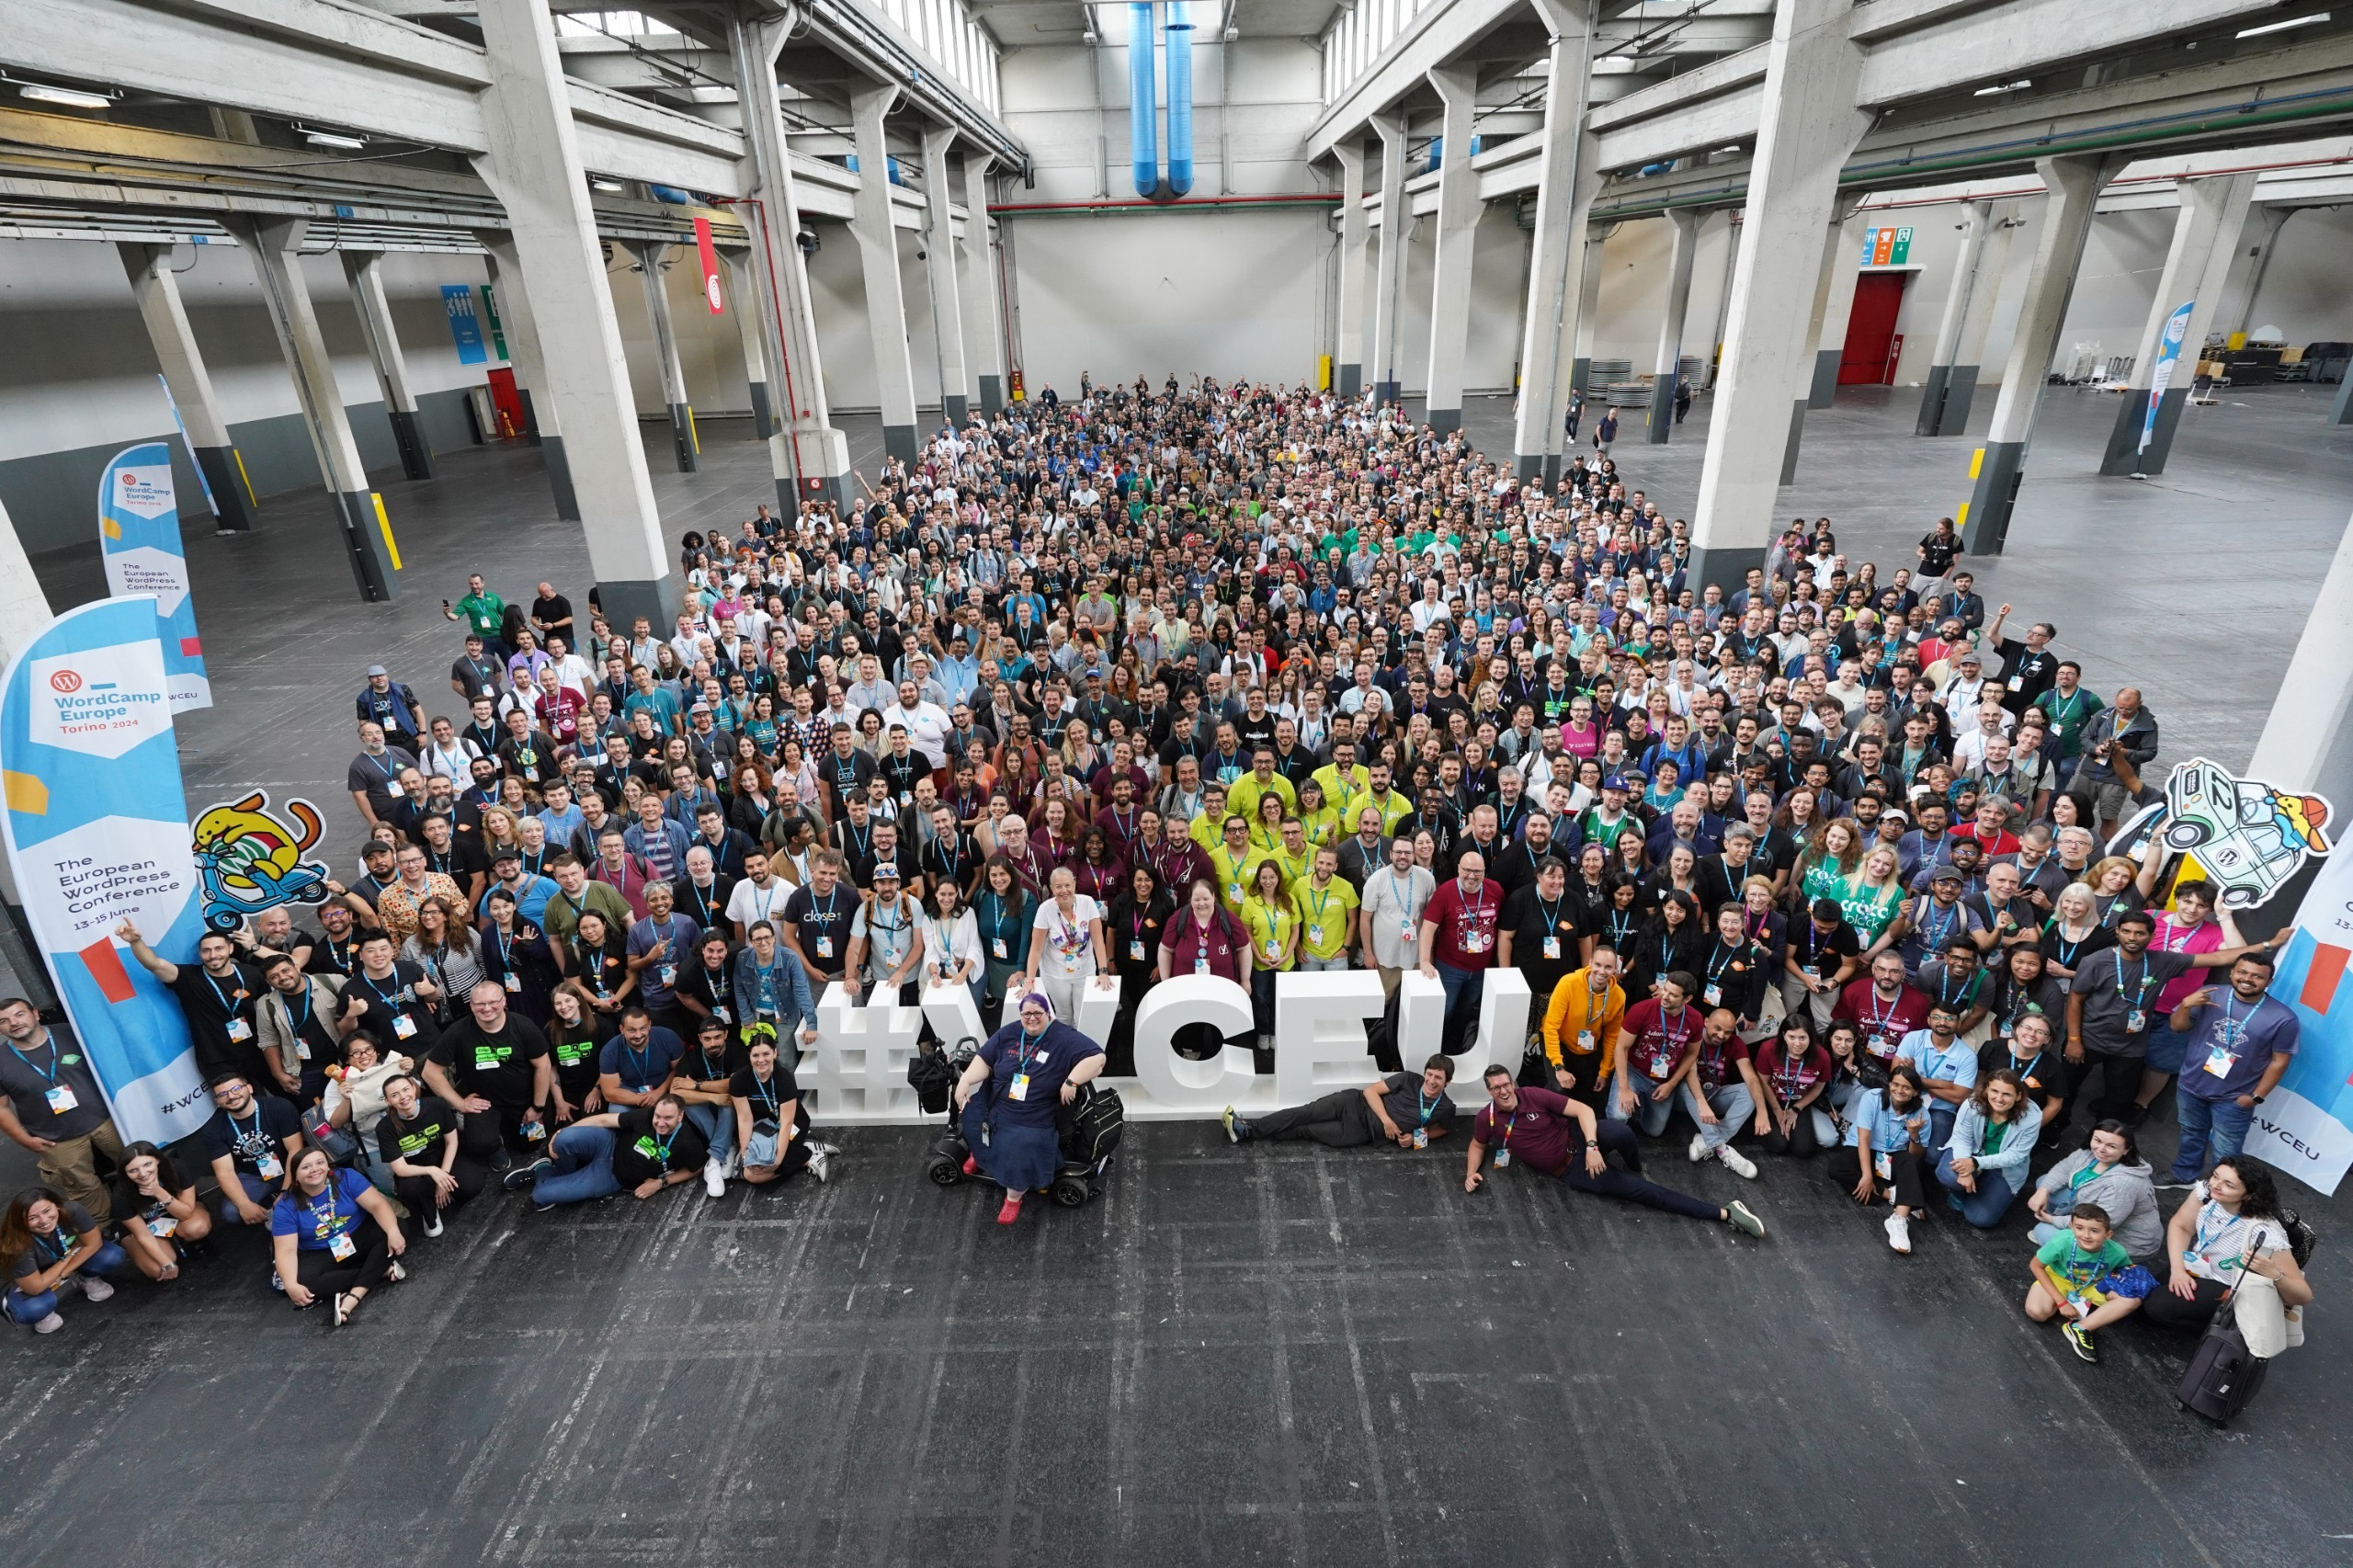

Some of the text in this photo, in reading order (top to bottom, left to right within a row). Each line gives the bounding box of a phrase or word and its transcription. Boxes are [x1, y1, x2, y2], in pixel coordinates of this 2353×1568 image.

[124, 486, 171, 496] WordCamp
[126, 493, 156, 501] Europe
[53, 692, 161, 709] WordCamp
[60, 707, 127, 722] Europe
[60, 719, 140, 734] Torino 2024
[2211, 770, 2234, 811] 12
[54, 856, 94, 872] The
[58, 859, 155, 888] European
[62, 869, 172, 901] WordPress
[67, 880, 181, 915] Conference
[108, 906, 140, 920] June
[802, 909, 837, 923] close
[1845, 912, 1879, 930] block
